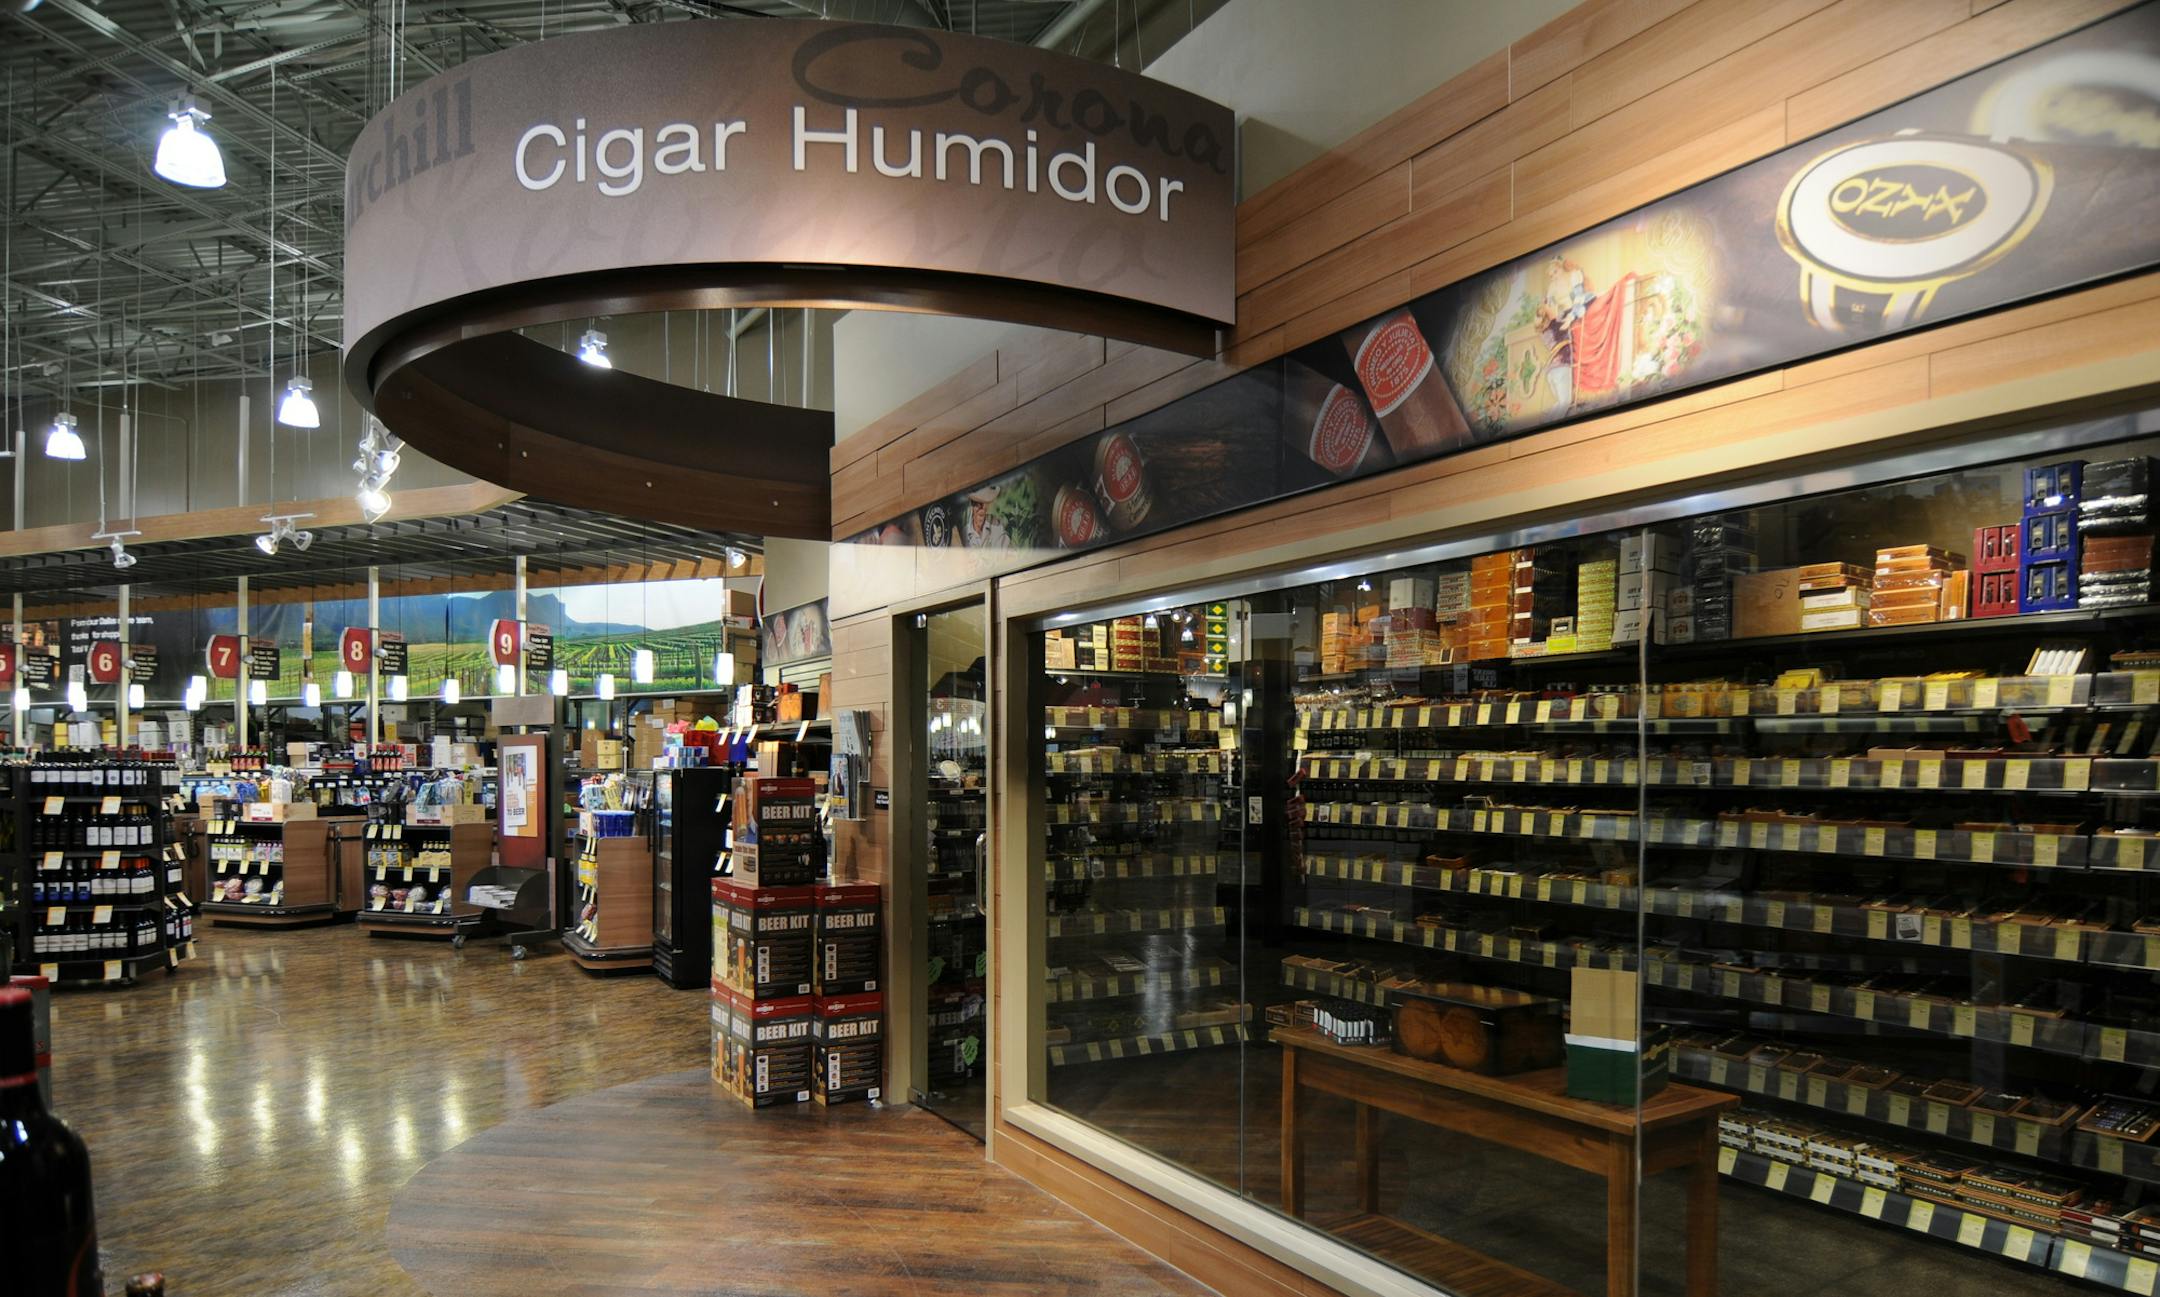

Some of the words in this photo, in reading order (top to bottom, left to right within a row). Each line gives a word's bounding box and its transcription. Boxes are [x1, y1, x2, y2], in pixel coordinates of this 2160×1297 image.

[792, 26, 1226, 175] Corona
[350, 78, 475, 225] rchill
[516, 118, 746, 196] Cigar
[793, 106, 1184, 221] Humidor
[351, 640, 364, 661] 8
[501, 633, 512, 655] 9
[99, 653, 113, 672] 6
[218, 647, 231, 666] 7
[762, 805, 790, 820] BEER
[792, 805, 811, 819] KIT
[758, 916, 787, 932] BEER
[790, 914, 809, 929] KIT
[825, 914, 855, 930] BEER
[856, 912, 876, 927] KIT
[757, 1024, 787, 1041] BEER
[788, 1021, 809, 1038] KIT
[828, 1022, 857, 1040] BEER
[859, 1019, 879, 1035] KIT
